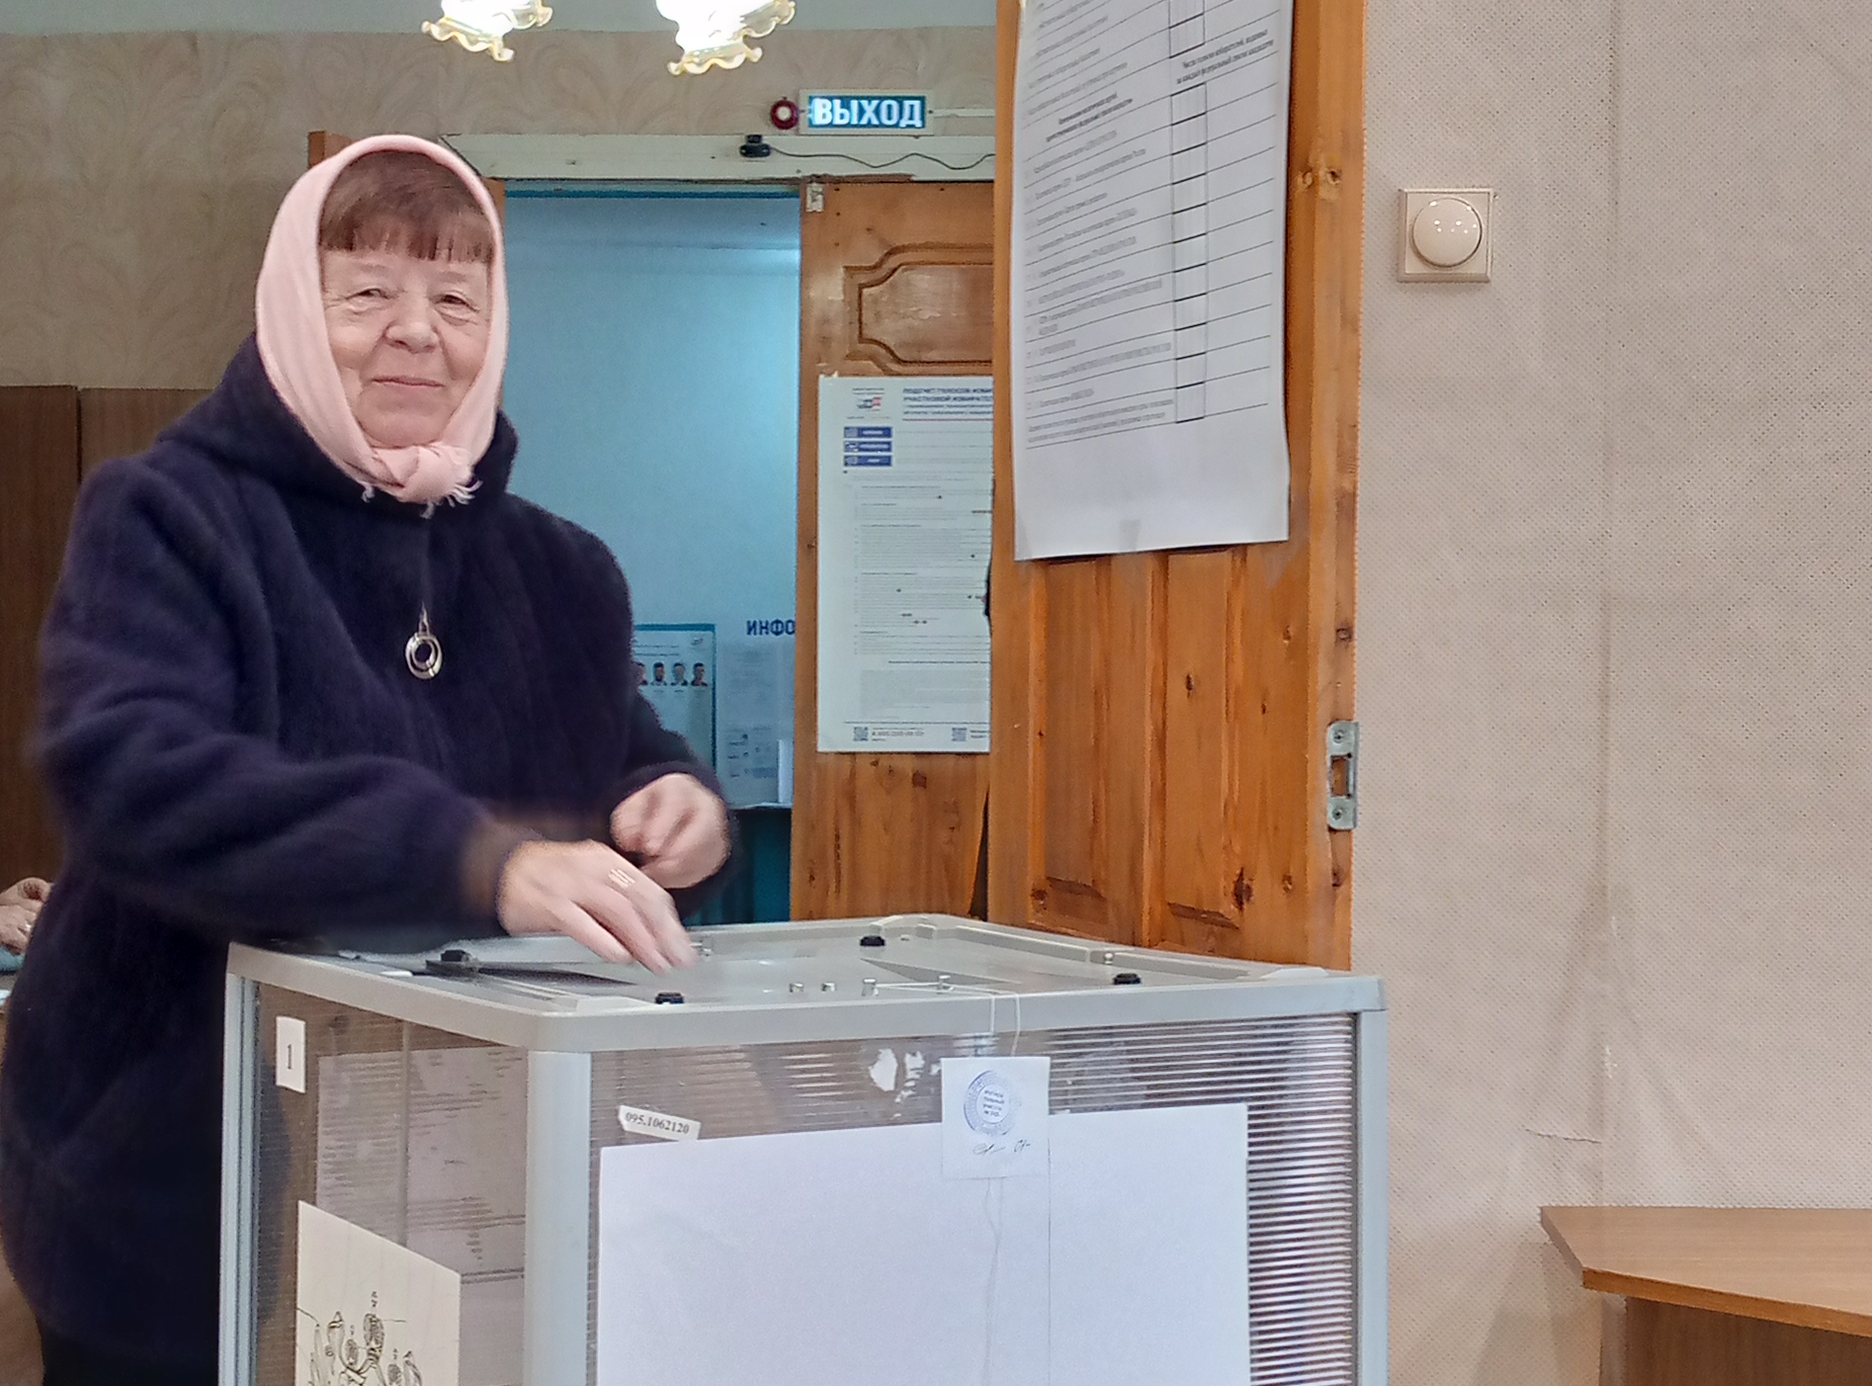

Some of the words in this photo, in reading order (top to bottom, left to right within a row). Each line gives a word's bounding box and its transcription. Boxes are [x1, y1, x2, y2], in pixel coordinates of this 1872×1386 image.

[812, 98, 923, 128] ВЫХОД
[286, 1043, 293, 1070] 1
[625, 1112, 690, 1135] 095.1062120
